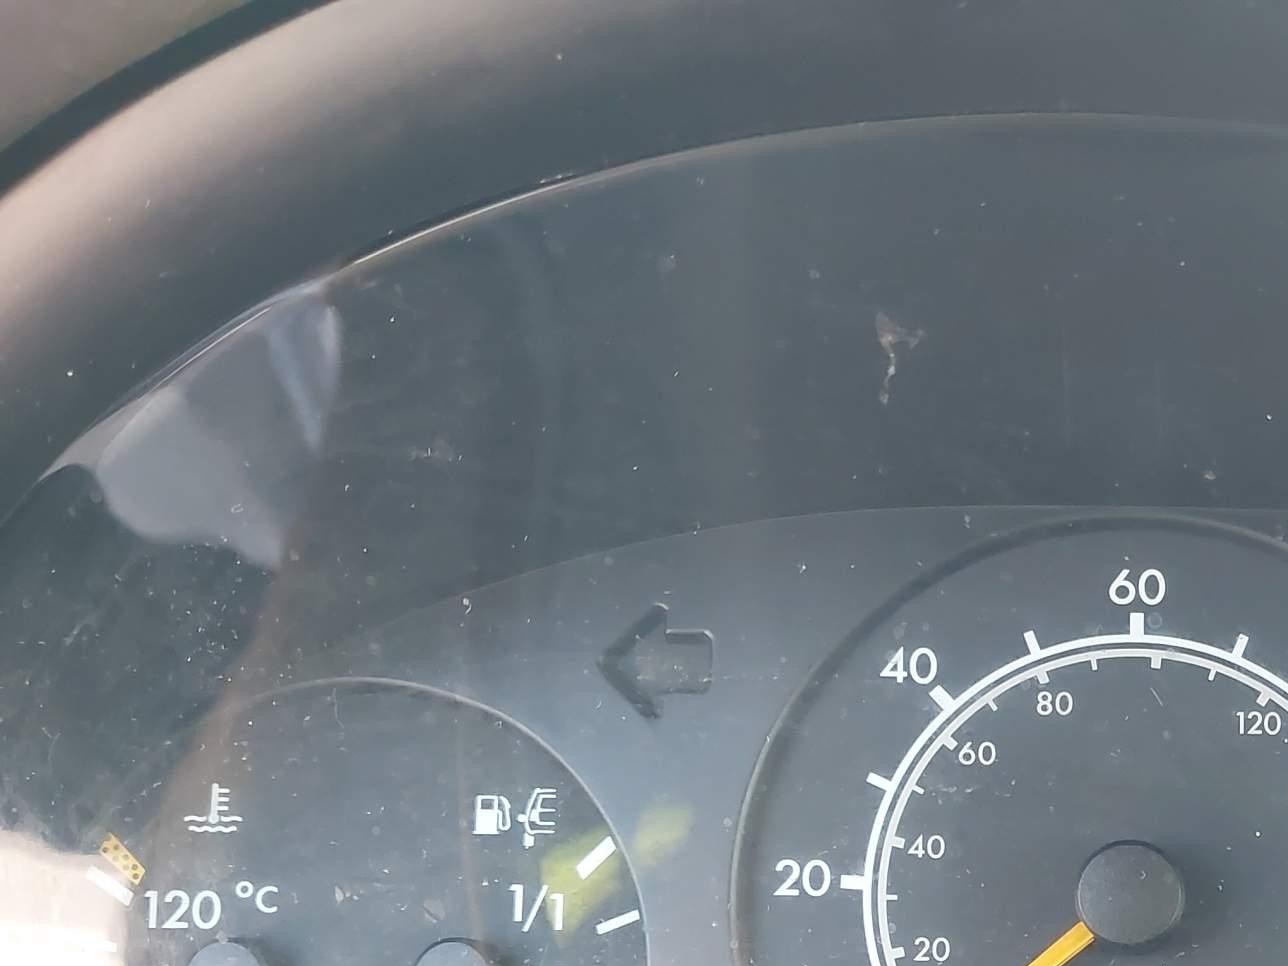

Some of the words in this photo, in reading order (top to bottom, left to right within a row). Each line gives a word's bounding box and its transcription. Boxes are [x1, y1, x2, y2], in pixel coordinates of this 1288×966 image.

[1108, 568, 1166, 606] 60
[879, 646, 938, 685] 40
[1036, 691, 1073, 716] 80
[1236, 711, 1282, 736] 120
[957, 741, 996, 766] 60
[907, 834, 946, 859] 40
[773, 859, 831, 897] 20
[144, 889, 222, 930] 120
[508, 883, 565, 933] 1/1
[913, 936, 951, 962] 20
